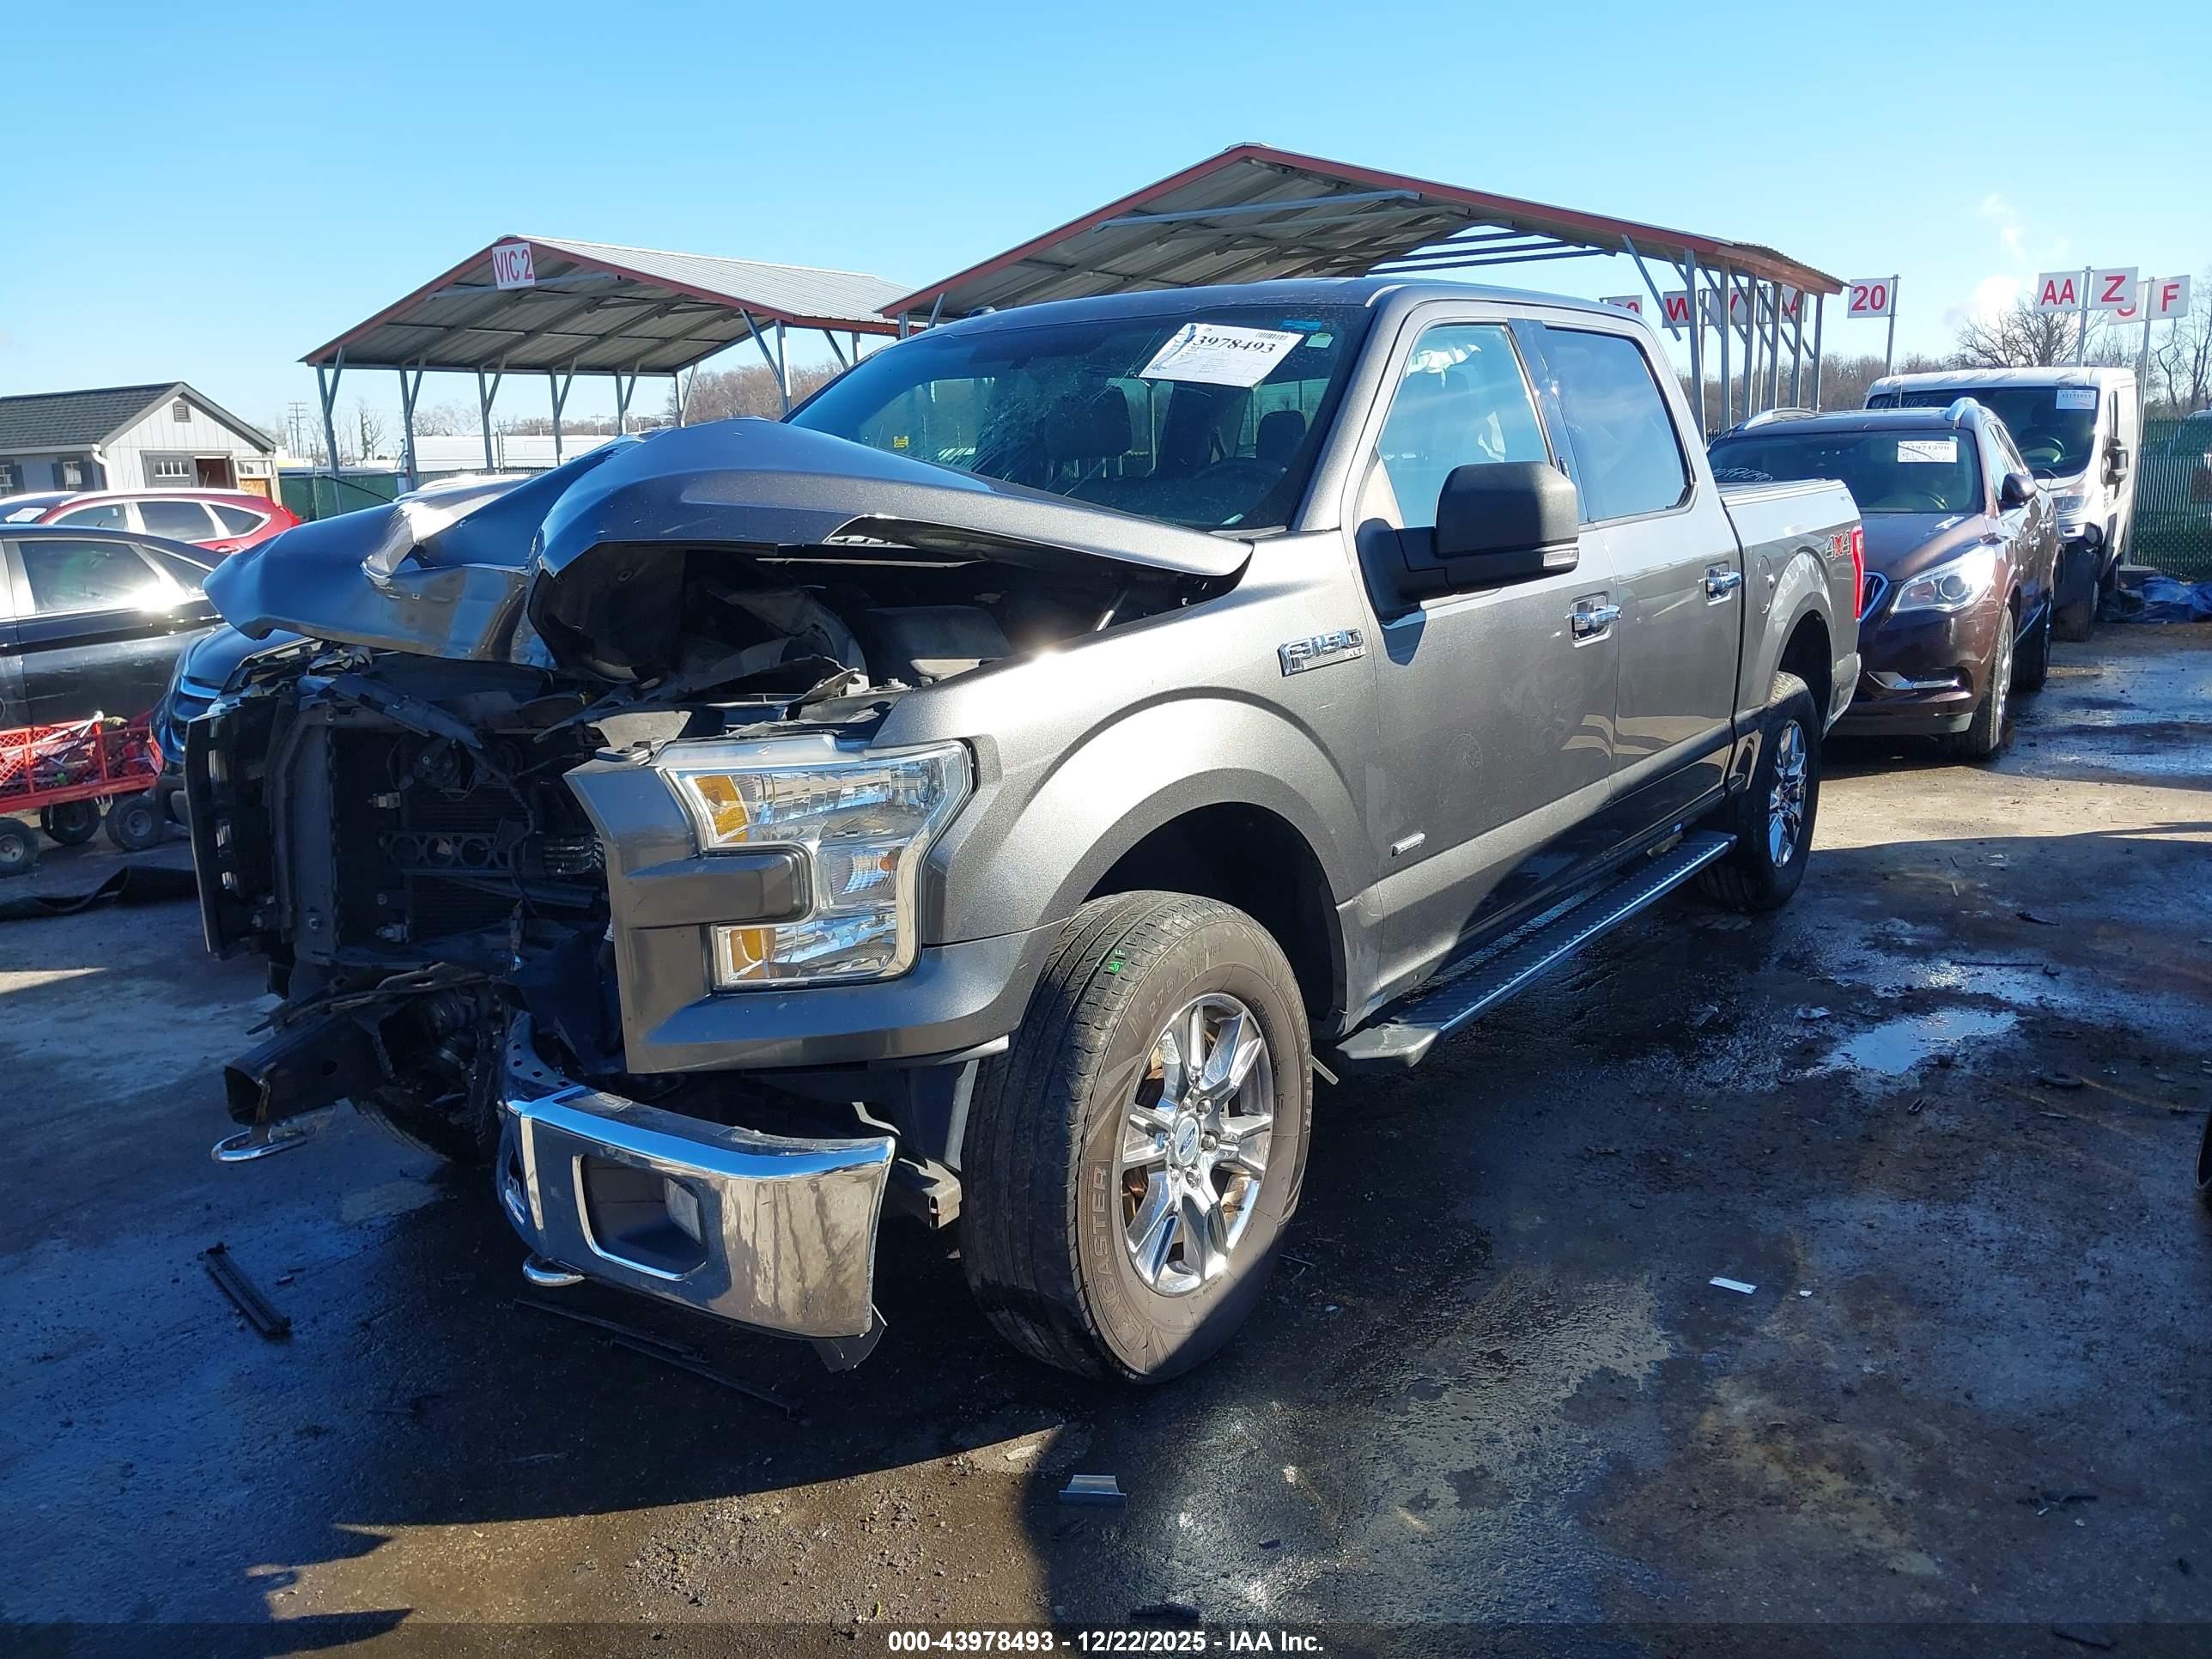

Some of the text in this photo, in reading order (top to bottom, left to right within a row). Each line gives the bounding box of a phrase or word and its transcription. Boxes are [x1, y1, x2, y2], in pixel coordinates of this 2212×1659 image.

[494, 248, 533, 283] VIC 2
[1851, 284, 1886, 312] 20
[2040, 278, 2075, 306] AA
[2101, 275, 2126, 303] Z
[2161, 283, 2180, 312] F
